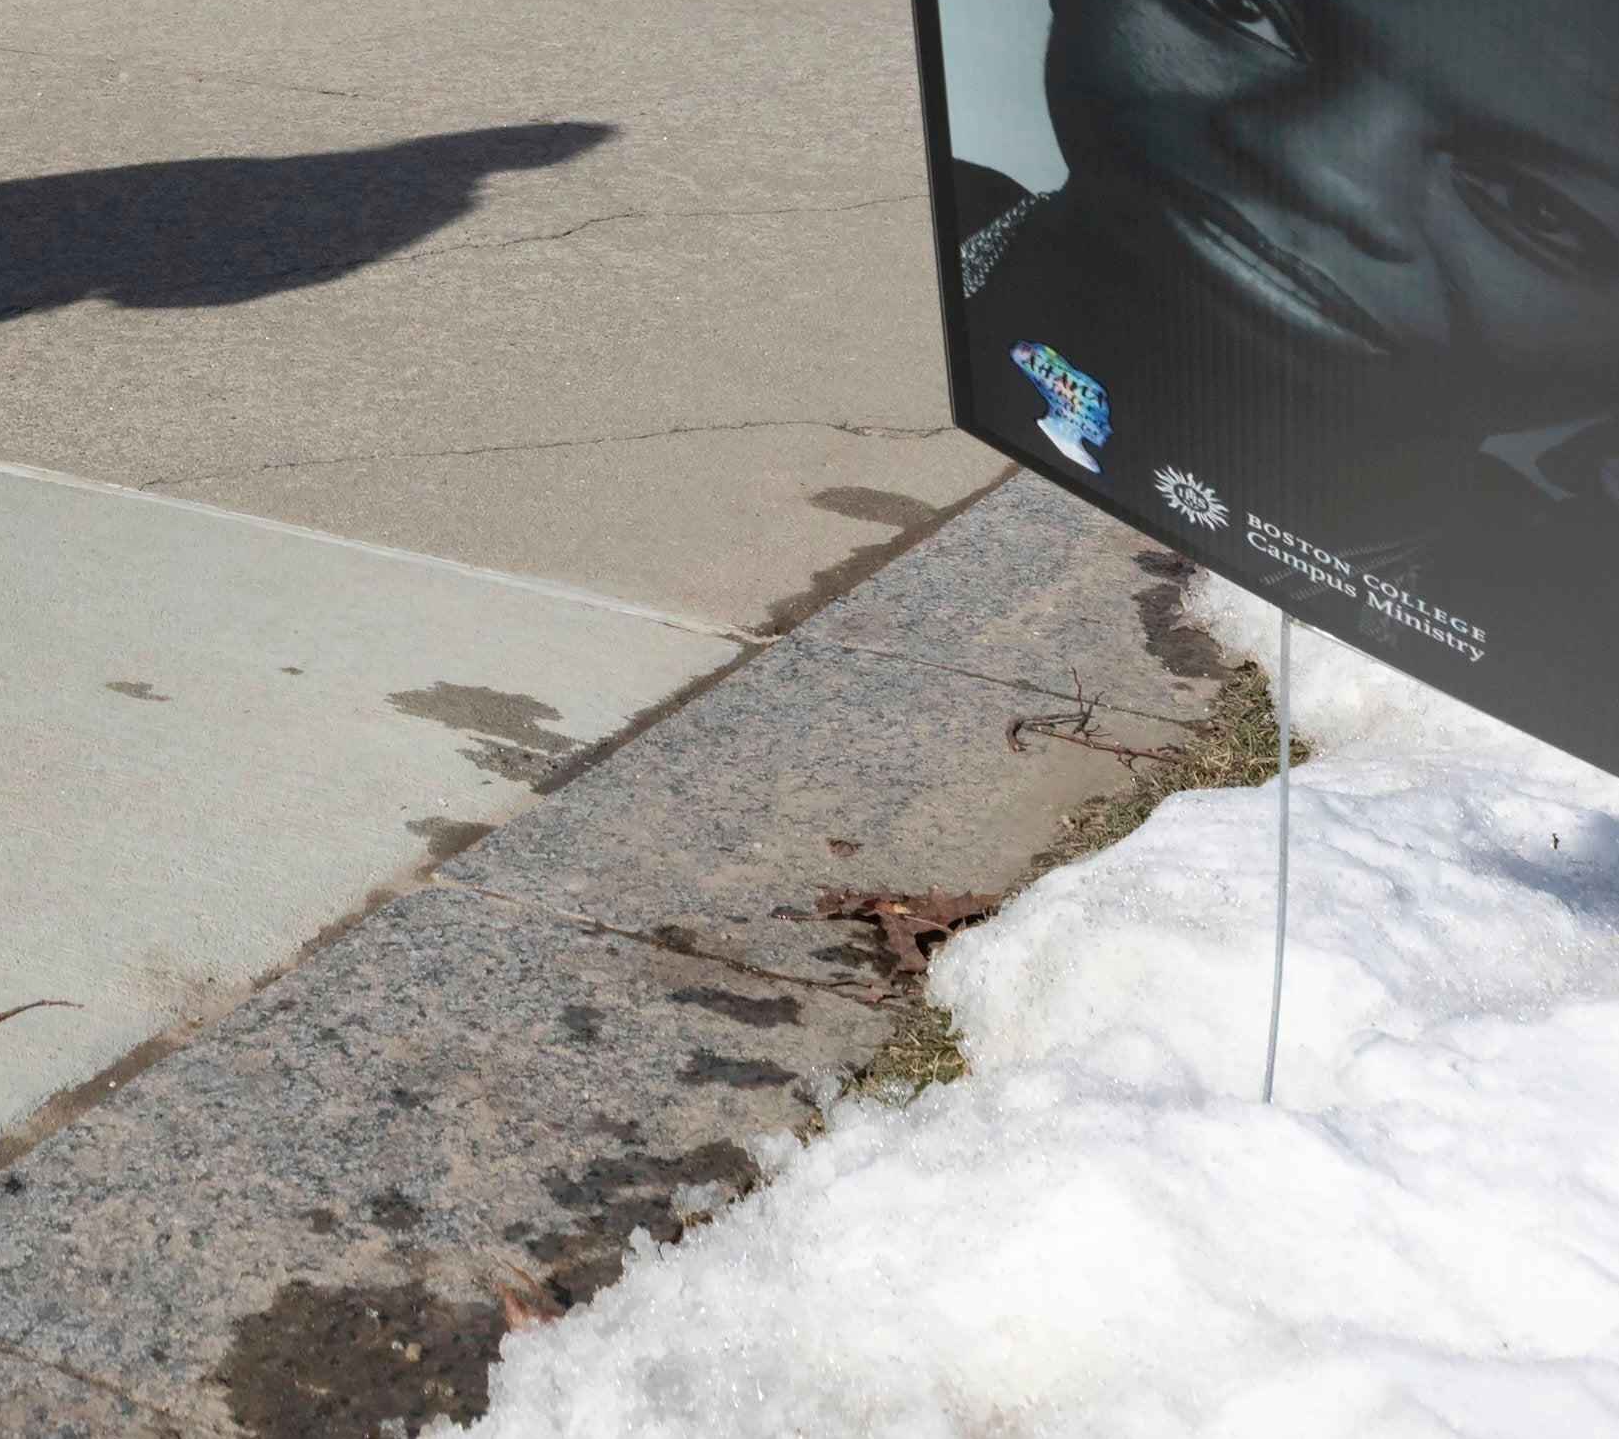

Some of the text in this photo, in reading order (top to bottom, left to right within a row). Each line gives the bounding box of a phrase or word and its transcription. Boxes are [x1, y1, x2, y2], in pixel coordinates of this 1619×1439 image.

[1246, 511, 1488, 644] BOSTON COLLEGE
[1246, 530, 1486, 664] Campus Ministry
